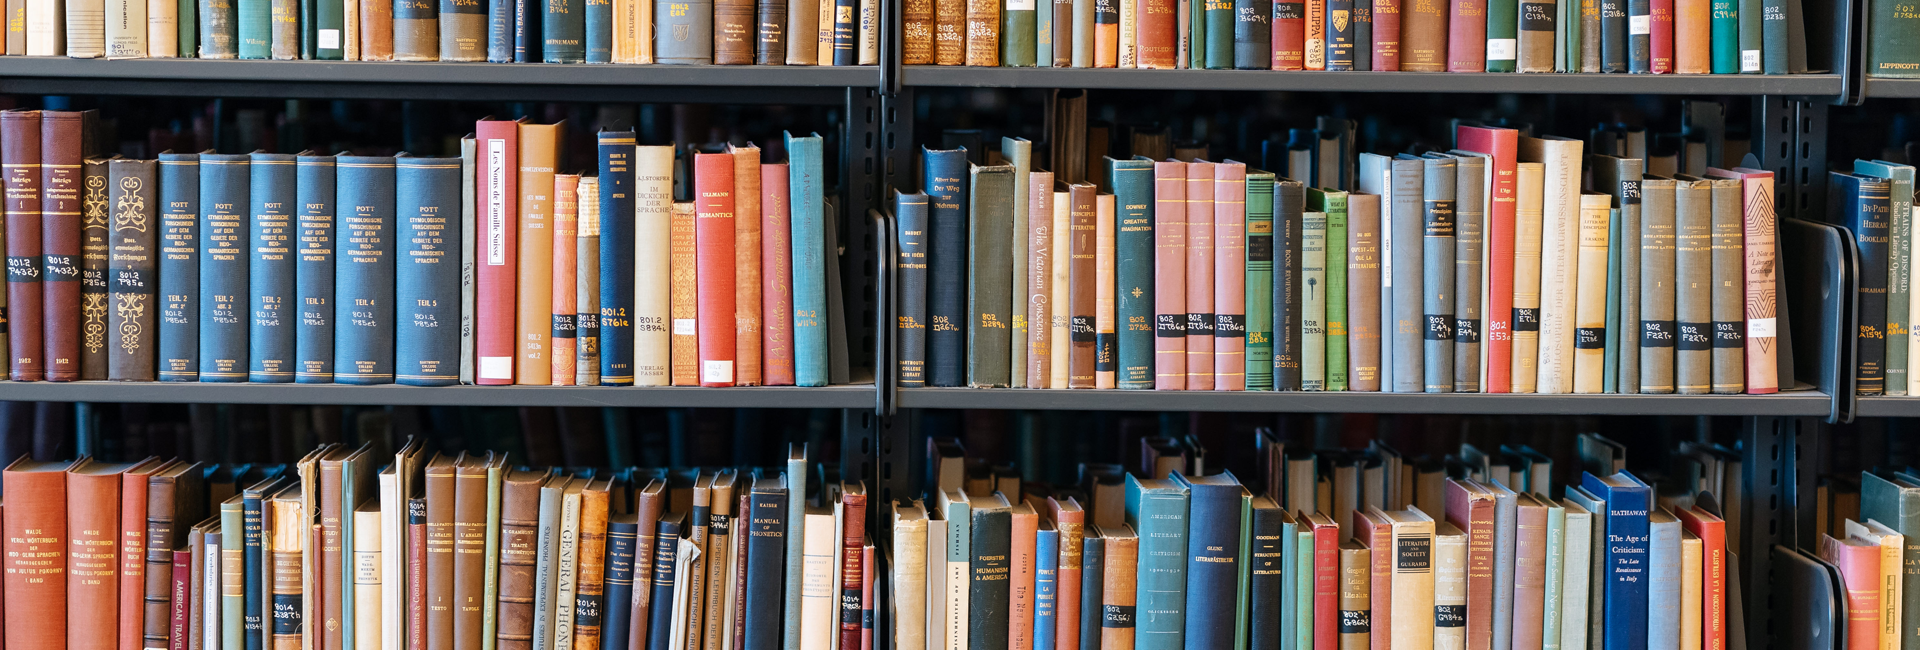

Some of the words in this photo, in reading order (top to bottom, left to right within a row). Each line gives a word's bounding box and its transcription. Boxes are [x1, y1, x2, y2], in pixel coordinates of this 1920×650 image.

[1526, 5, 1543, 13] 802
[493, 191, 501, 200] de
[493, 202, 501, 231] Famille
[769, 193, 782, 226] Urzeit
[1556, 154, 1568, 283] LITERATURWISSENSCHAFT
[1902, 201, 1910, 236] STRAINS
[1036, 226, 1047, 246] The
[1863, 220, 1888, 228] HEBRAIC
[493, 233, 501, 258] Suisse
[1902, 240, 1909, 251] OF
[8, 258, 30, 266] 801.2
[48, 256, 69, 265] 801.2
[1036, 247, 1047, 289] Victorian
[83, 279, 106, 287] P85e
[118, 279, 143, 287] P85e
[1901, 255, 1909, 294] DISCORD:
[601, 308, 626, 316] 801.2
[769, 300, 786, 342] Wadler,
[1032, 294, 1047, 341] Conscience
[1490, 321, 1506, 329] 802
[1553, 313, 1563, 380] PHILOSOPHIE
[542, 526, 550, 561] PHONETICS
[1625, 535, 1639, 543] Age
[560, 529, 573, 596] GENERAL
[540, 565, 548, 611] EXPERIMENTAL
[1551, 568, 1559, 593] Southern
[1712, 579, 1720, 587] LA
[175, 580, 183, 620] AMERICAN
[691, 575, 699, 629] PHONETISCHE
[1549, 595, 1558, 609] New
[1549, 610, 1557, 629] Critics
